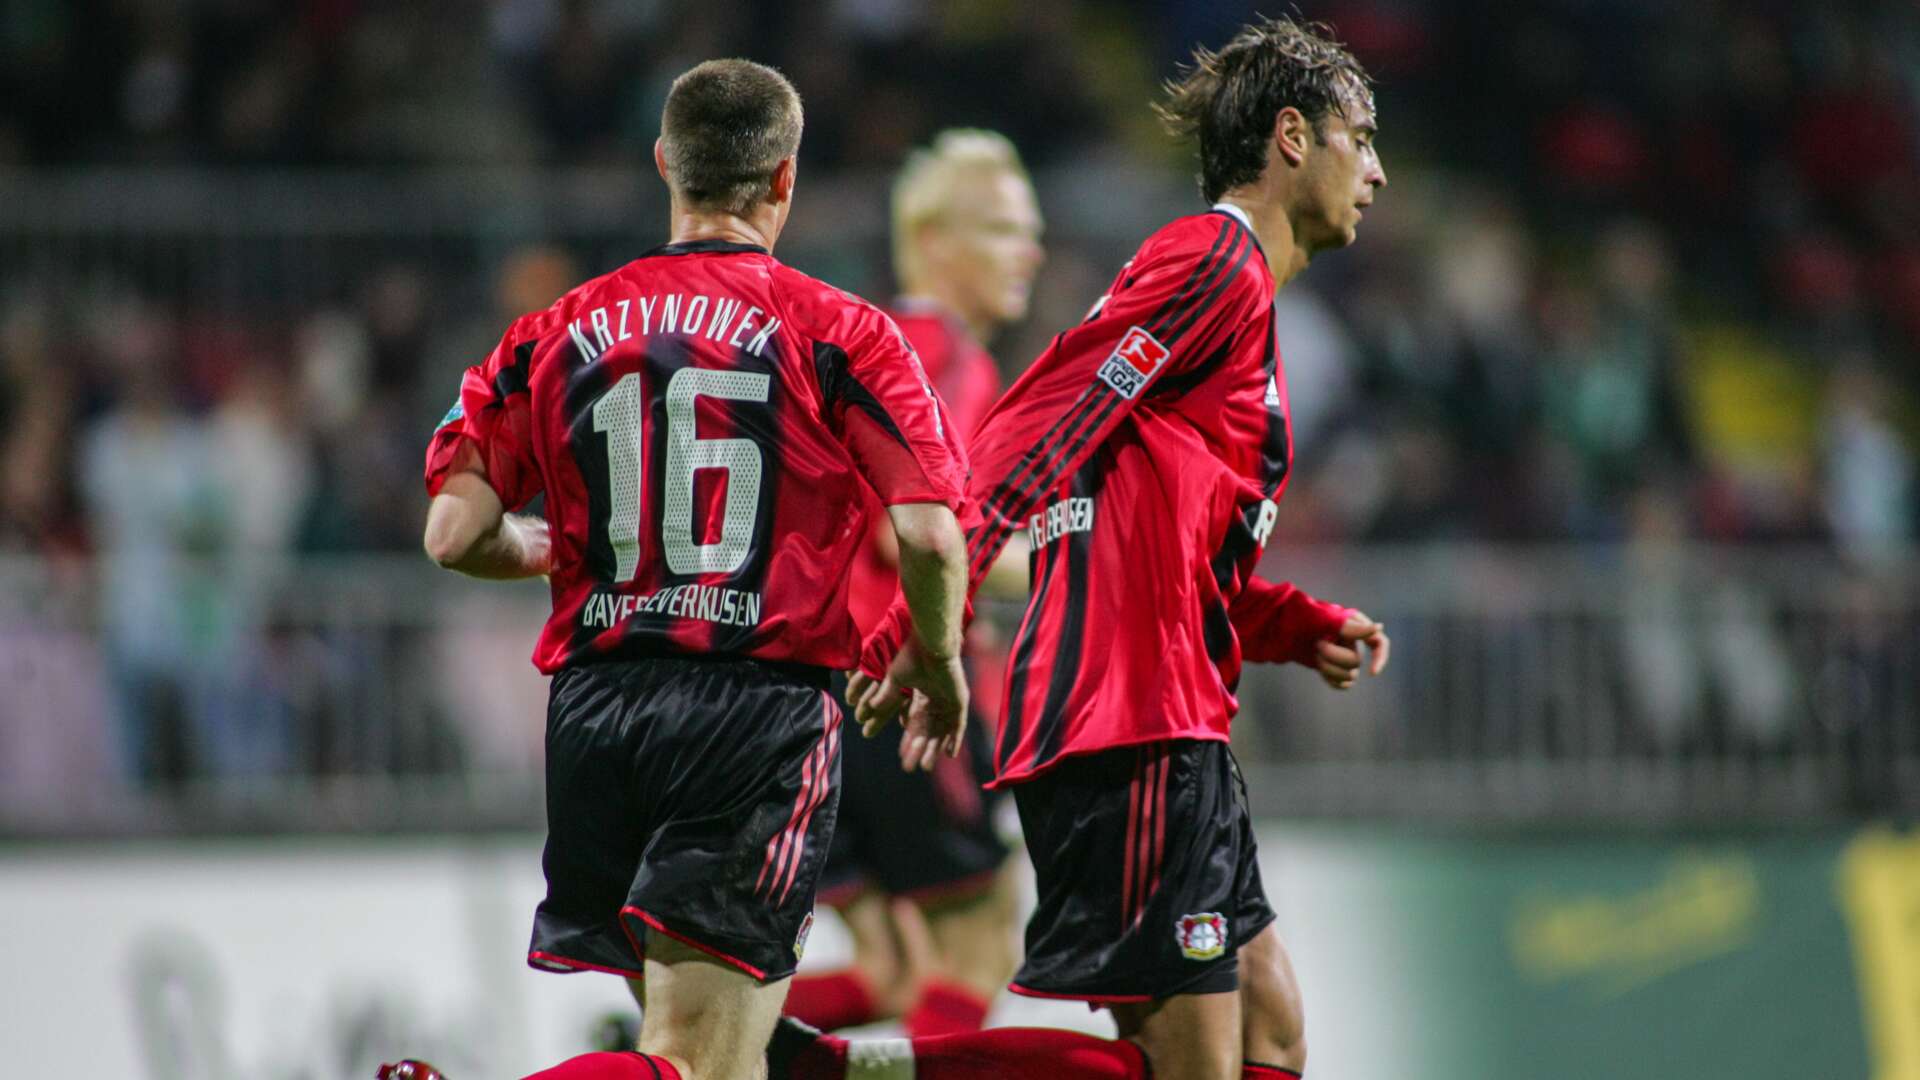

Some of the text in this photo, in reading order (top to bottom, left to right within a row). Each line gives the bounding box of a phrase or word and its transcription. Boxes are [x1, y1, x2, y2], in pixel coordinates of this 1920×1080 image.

[568, 293, 782, 364] KRZYNOWEK
[1100, 363, 1136, 397] LIGA
[592, 366, 771, 583] 16
[642, 584, 761, 627] EVERKUSEN
